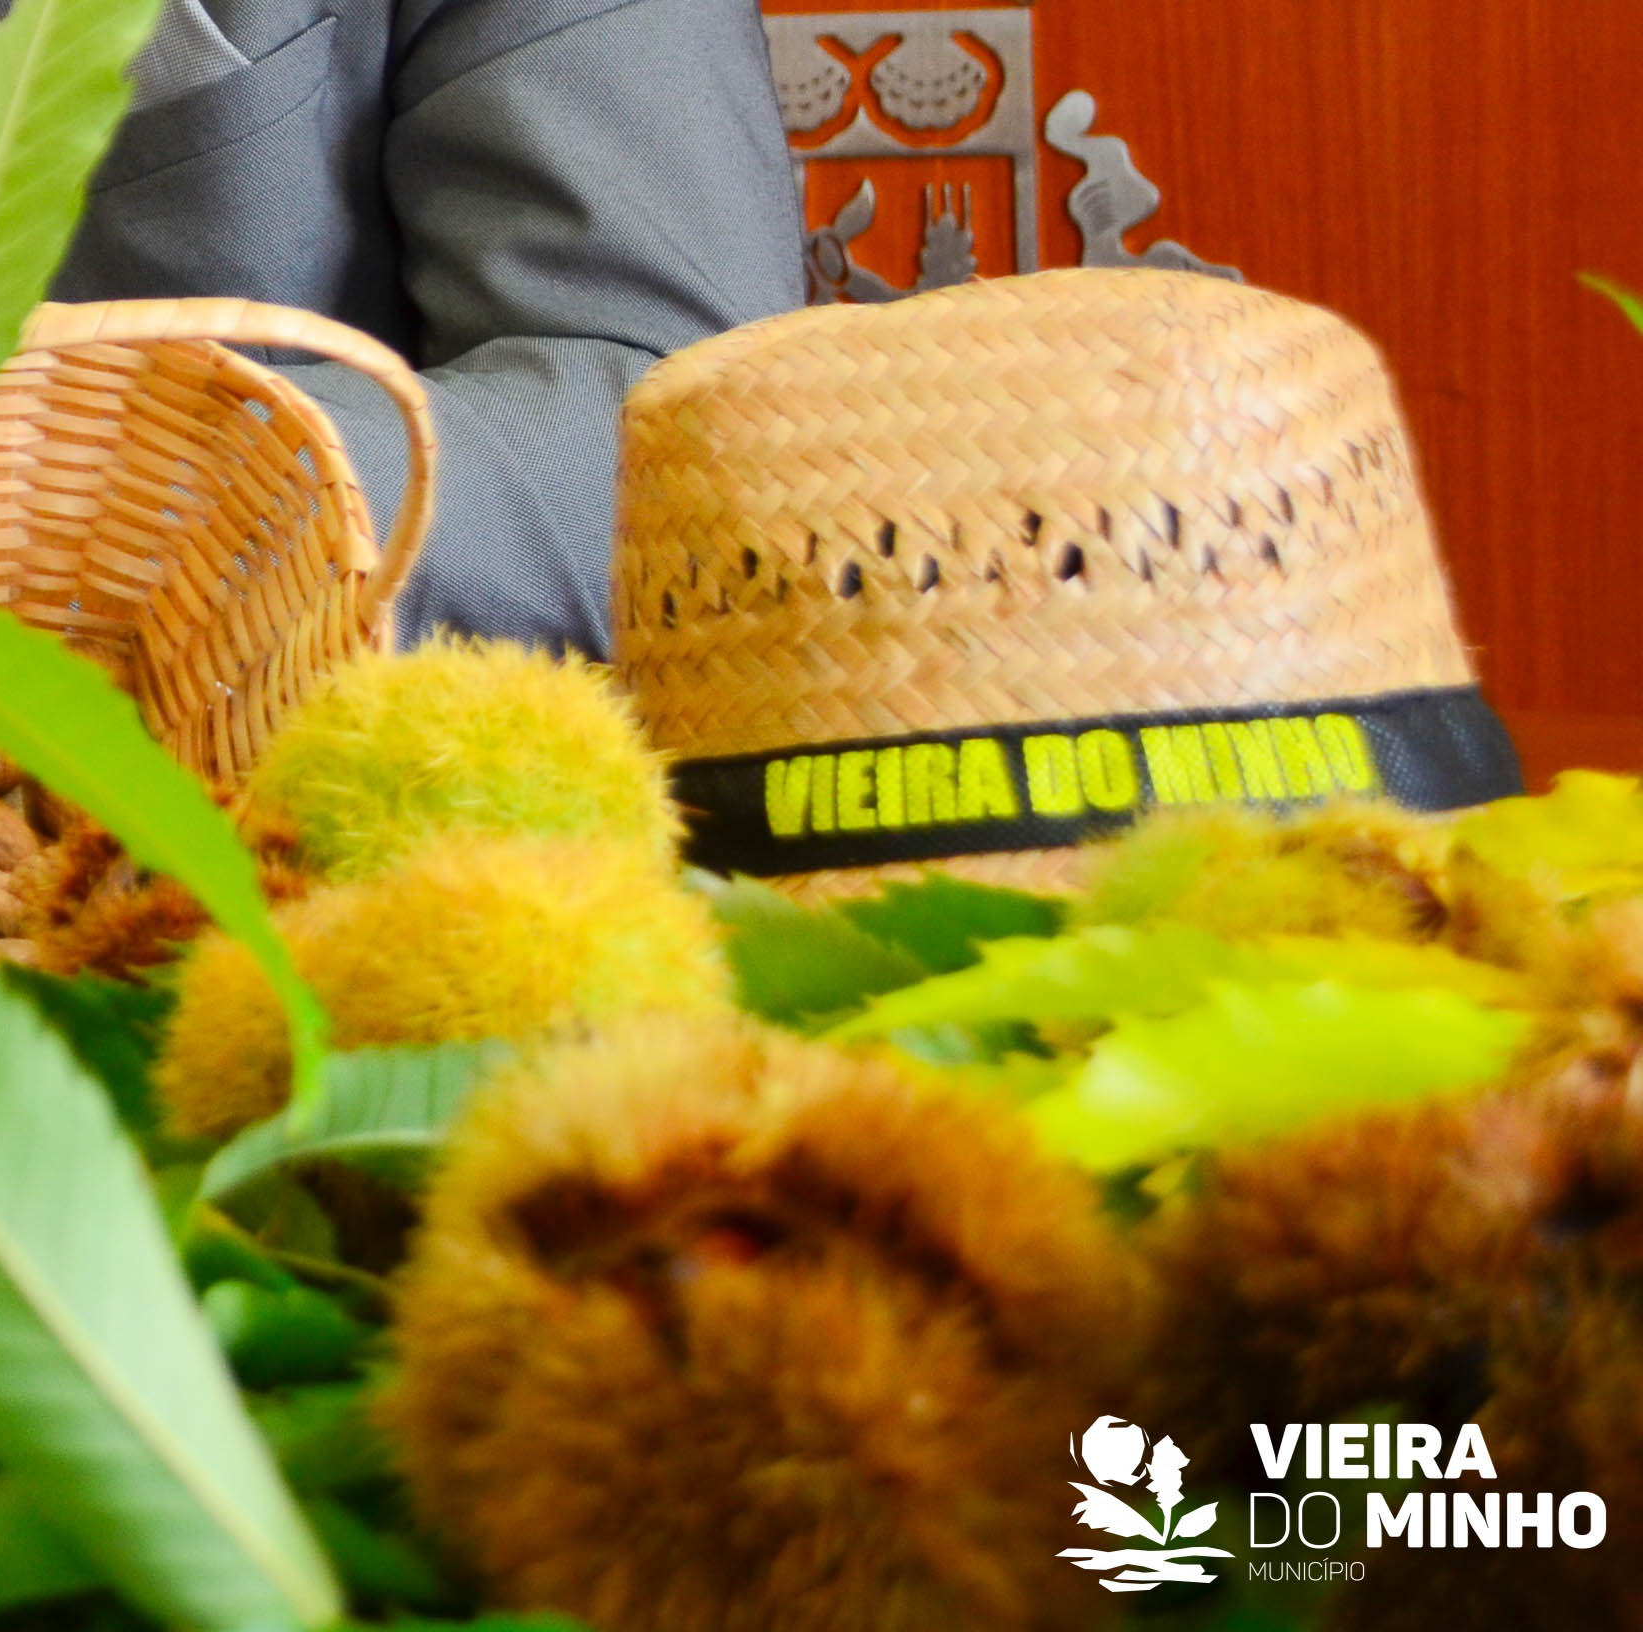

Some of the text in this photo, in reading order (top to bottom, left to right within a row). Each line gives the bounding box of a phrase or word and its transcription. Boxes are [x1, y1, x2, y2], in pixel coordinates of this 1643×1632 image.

[765, 713, 1373, 838] VIEIRA DO MINHO
